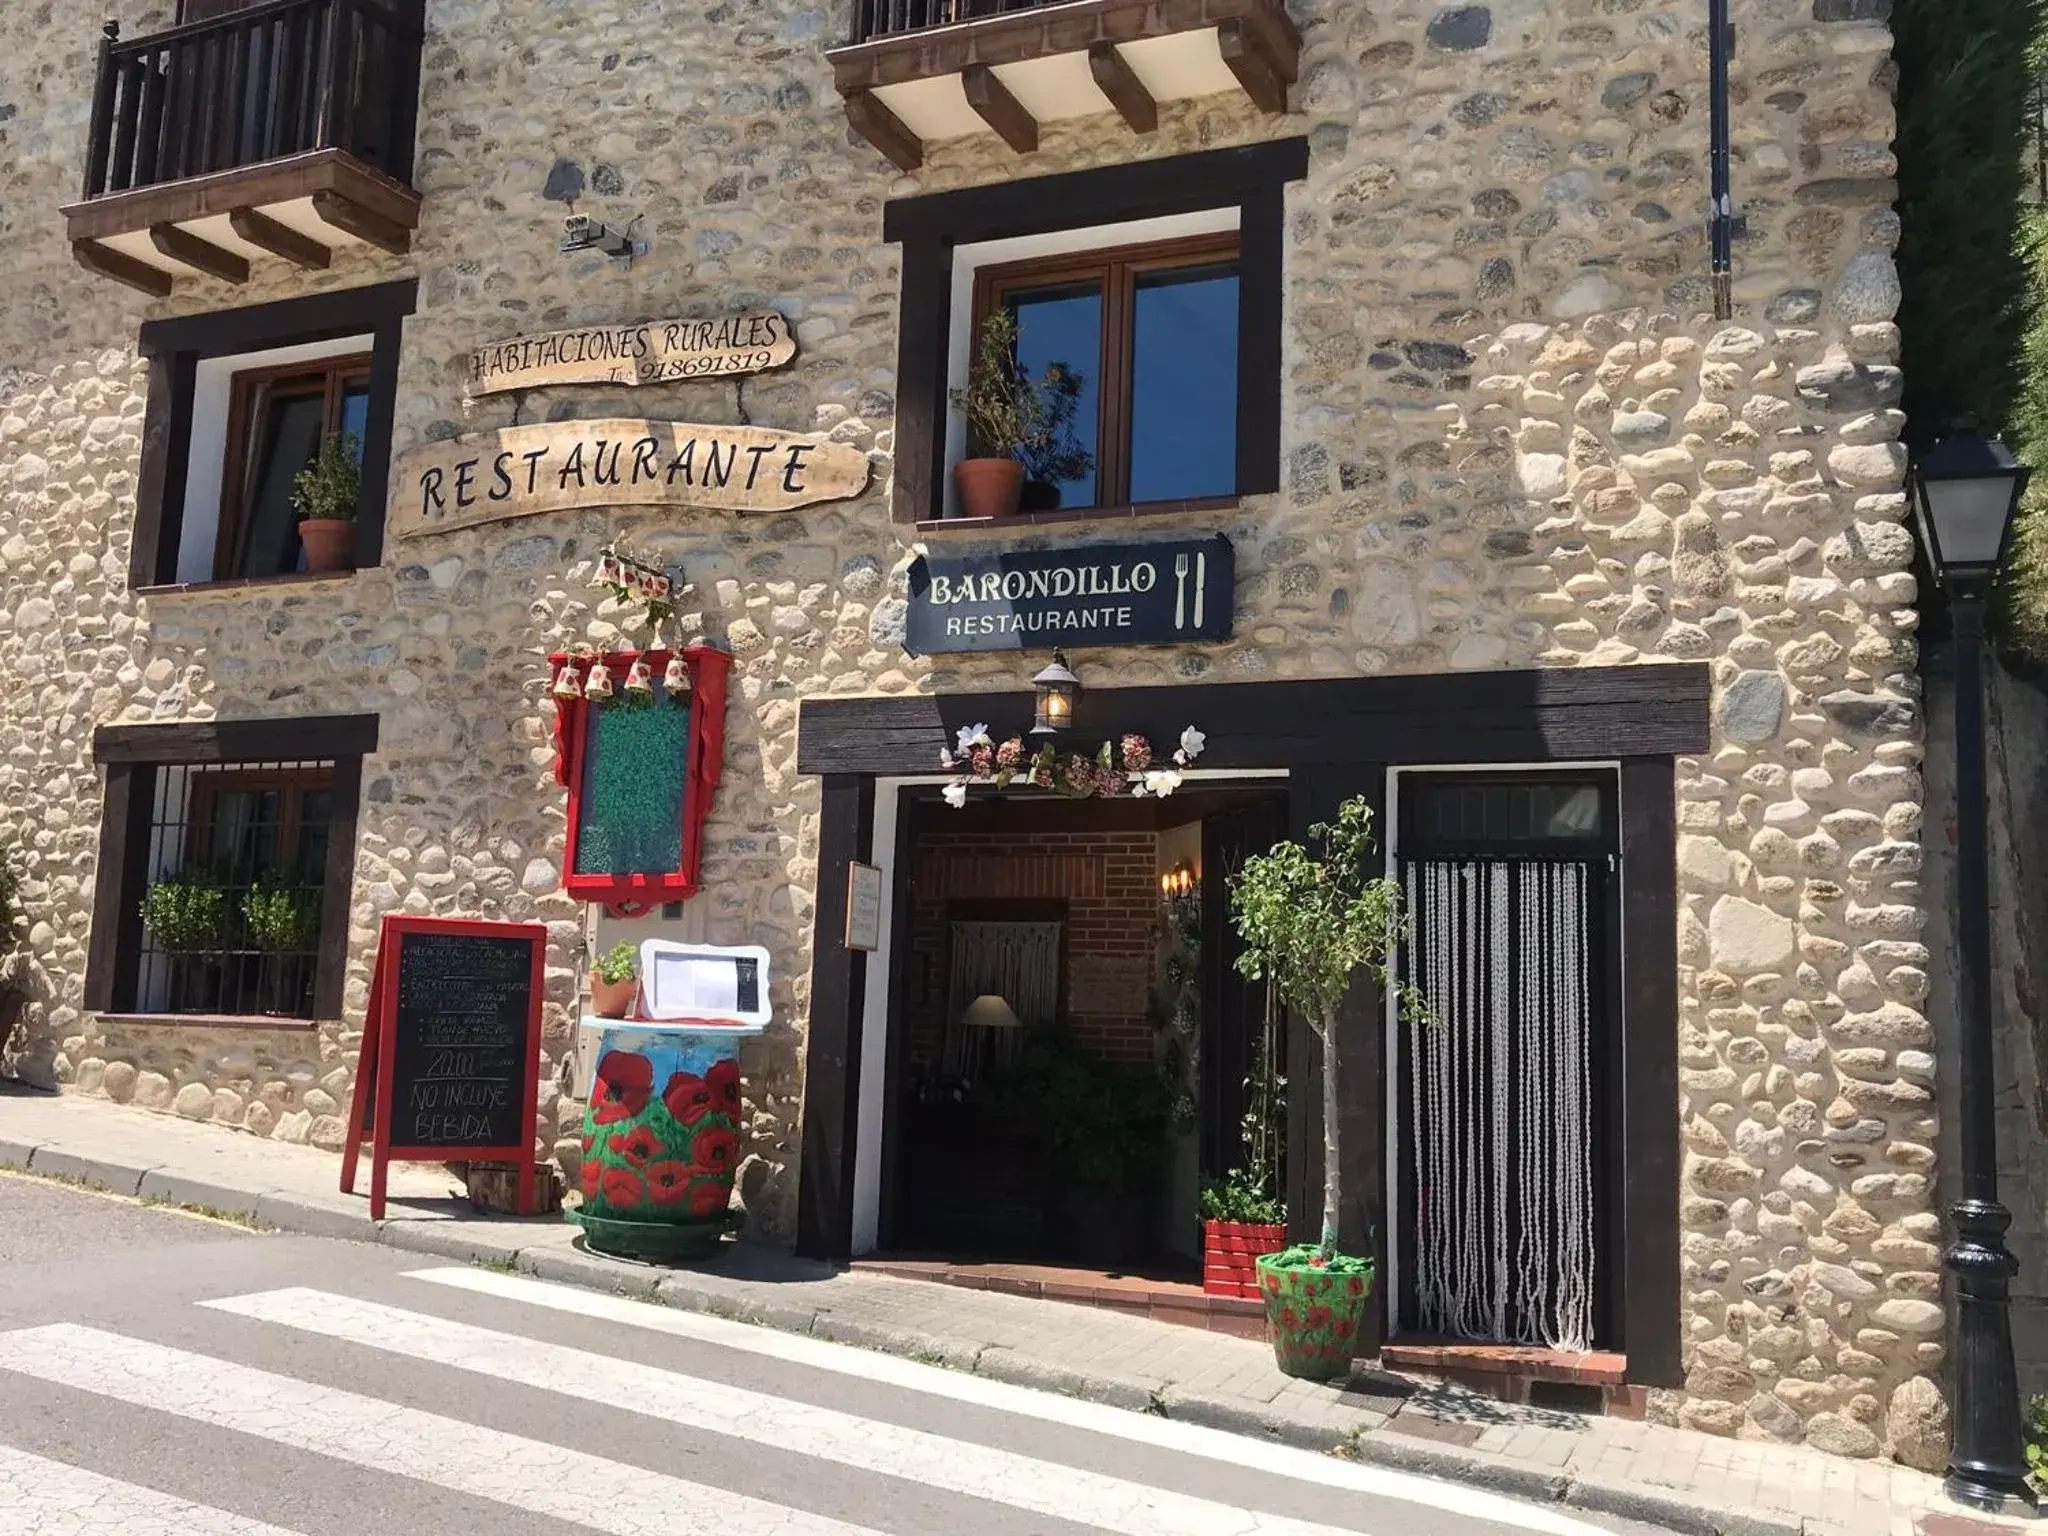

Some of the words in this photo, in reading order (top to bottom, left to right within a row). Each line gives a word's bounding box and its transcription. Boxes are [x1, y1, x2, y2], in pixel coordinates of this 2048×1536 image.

[473, 327, 649, 381] HABITACIONES
[664, 314, 780, 353] RURALES
[639, 351, 772, 380] 918691819
[420, 437, 817, 516] RESTAURANTE
[929, 561, 1157, 605] BARONDILLO
[946, 606, 1132, 636] RESTAURANTE
[410, 1083, 441, 1109] NO
[444, 1083, 509, 1108] INCLUYE
[414, 1112, 494, 1141] BEBIDA
